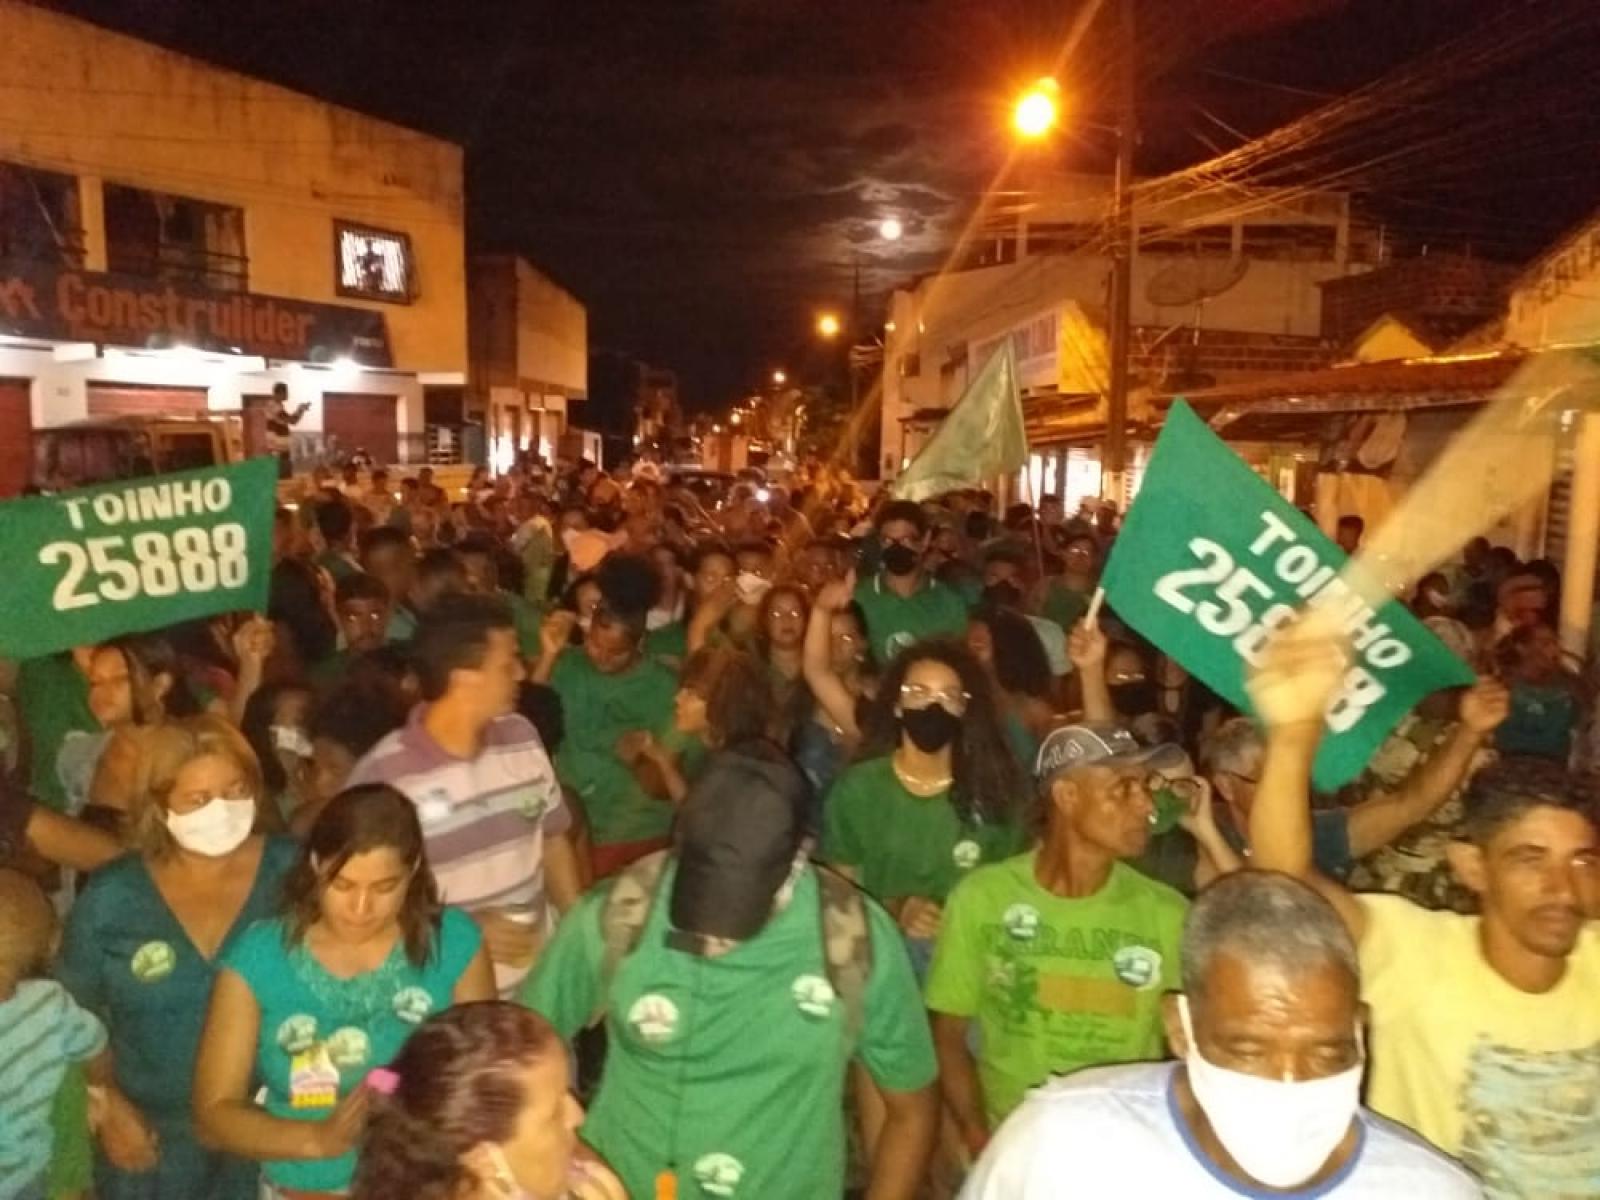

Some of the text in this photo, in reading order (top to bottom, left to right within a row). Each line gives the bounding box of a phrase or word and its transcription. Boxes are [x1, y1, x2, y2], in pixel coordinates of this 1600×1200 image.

[57, 272, 315, 340] Construlider
[60, 477, 232, 530] TOINHO
[38, 523, 248, 611] 25888
[1153, 537, 1387, 733] 2588
